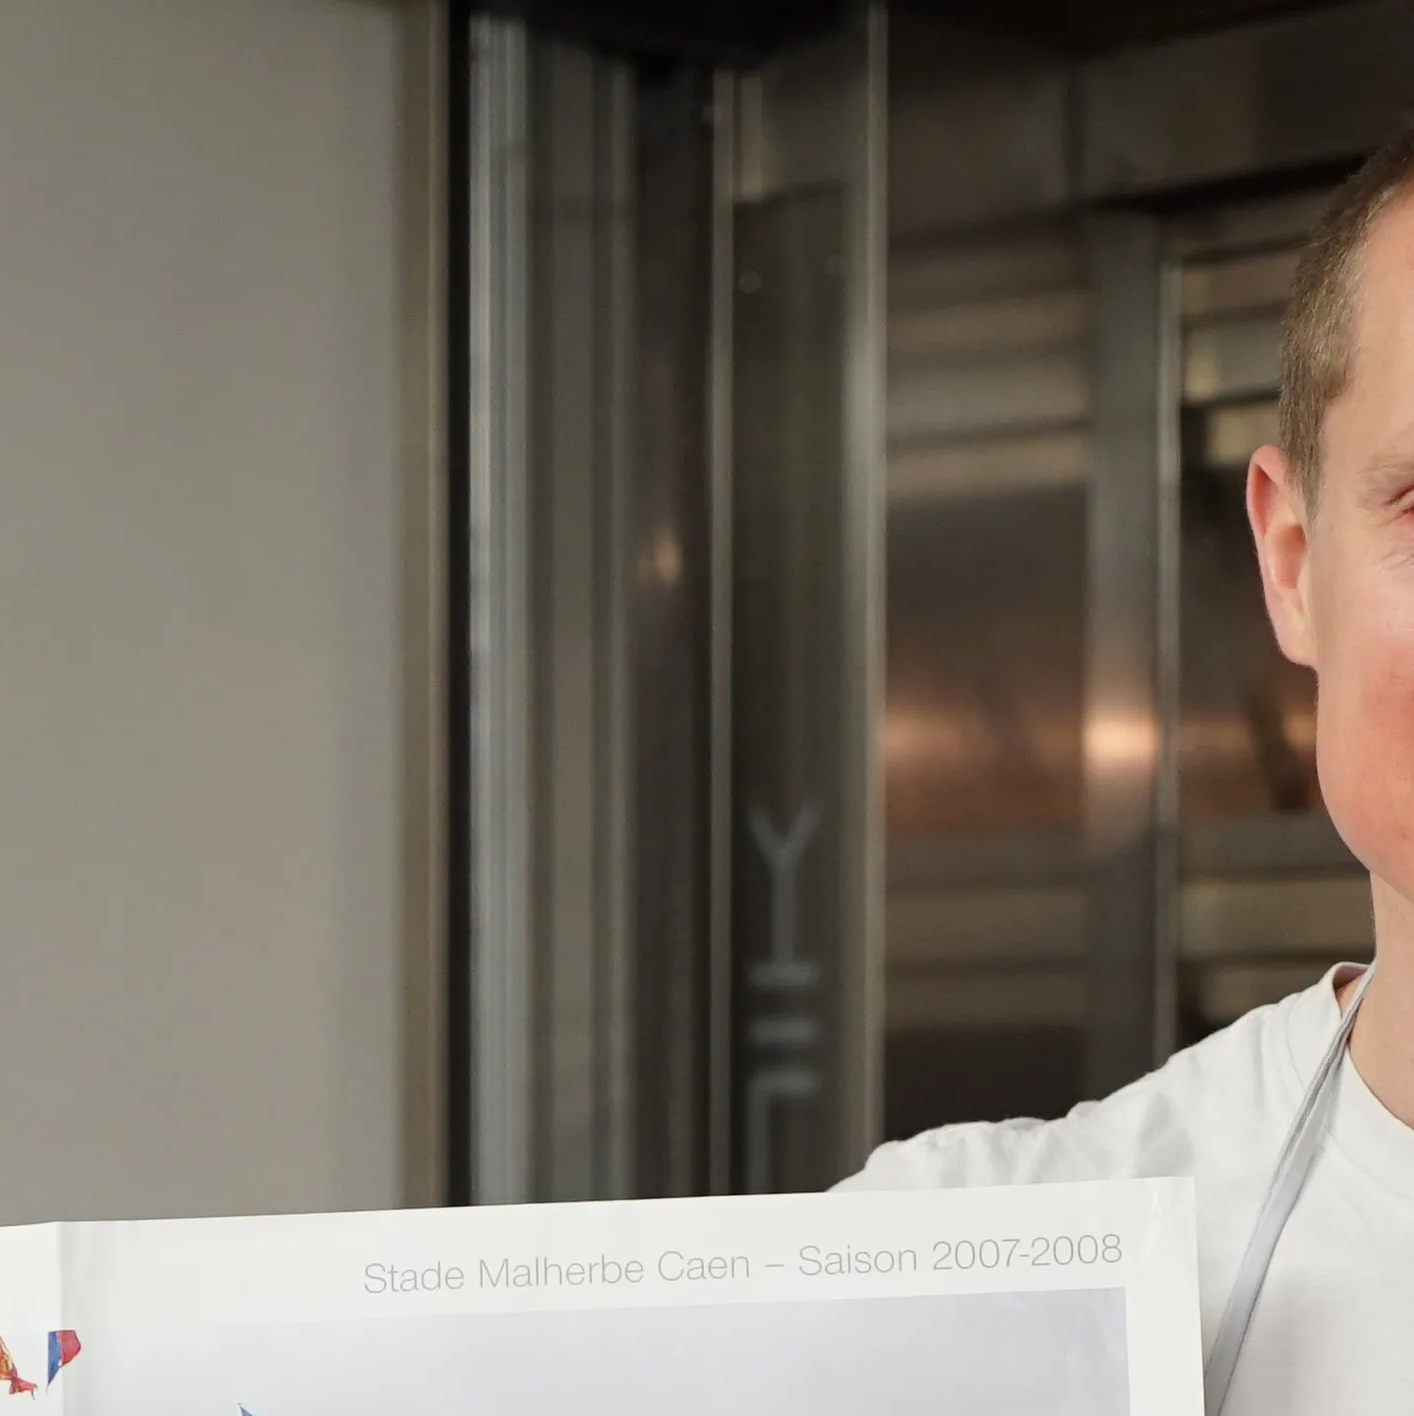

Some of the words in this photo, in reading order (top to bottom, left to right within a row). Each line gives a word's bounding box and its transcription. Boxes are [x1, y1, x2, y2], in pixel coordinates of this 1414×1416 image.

[364, 1261, 464, 1293] Stade
[480, 1254, 643, 1288] Malherbe
[658, 1251, 749, 1281] Caen
[799, 1245, 916, 1276] Saison
[933, 1234, 1122, 1270] 2007-2008
